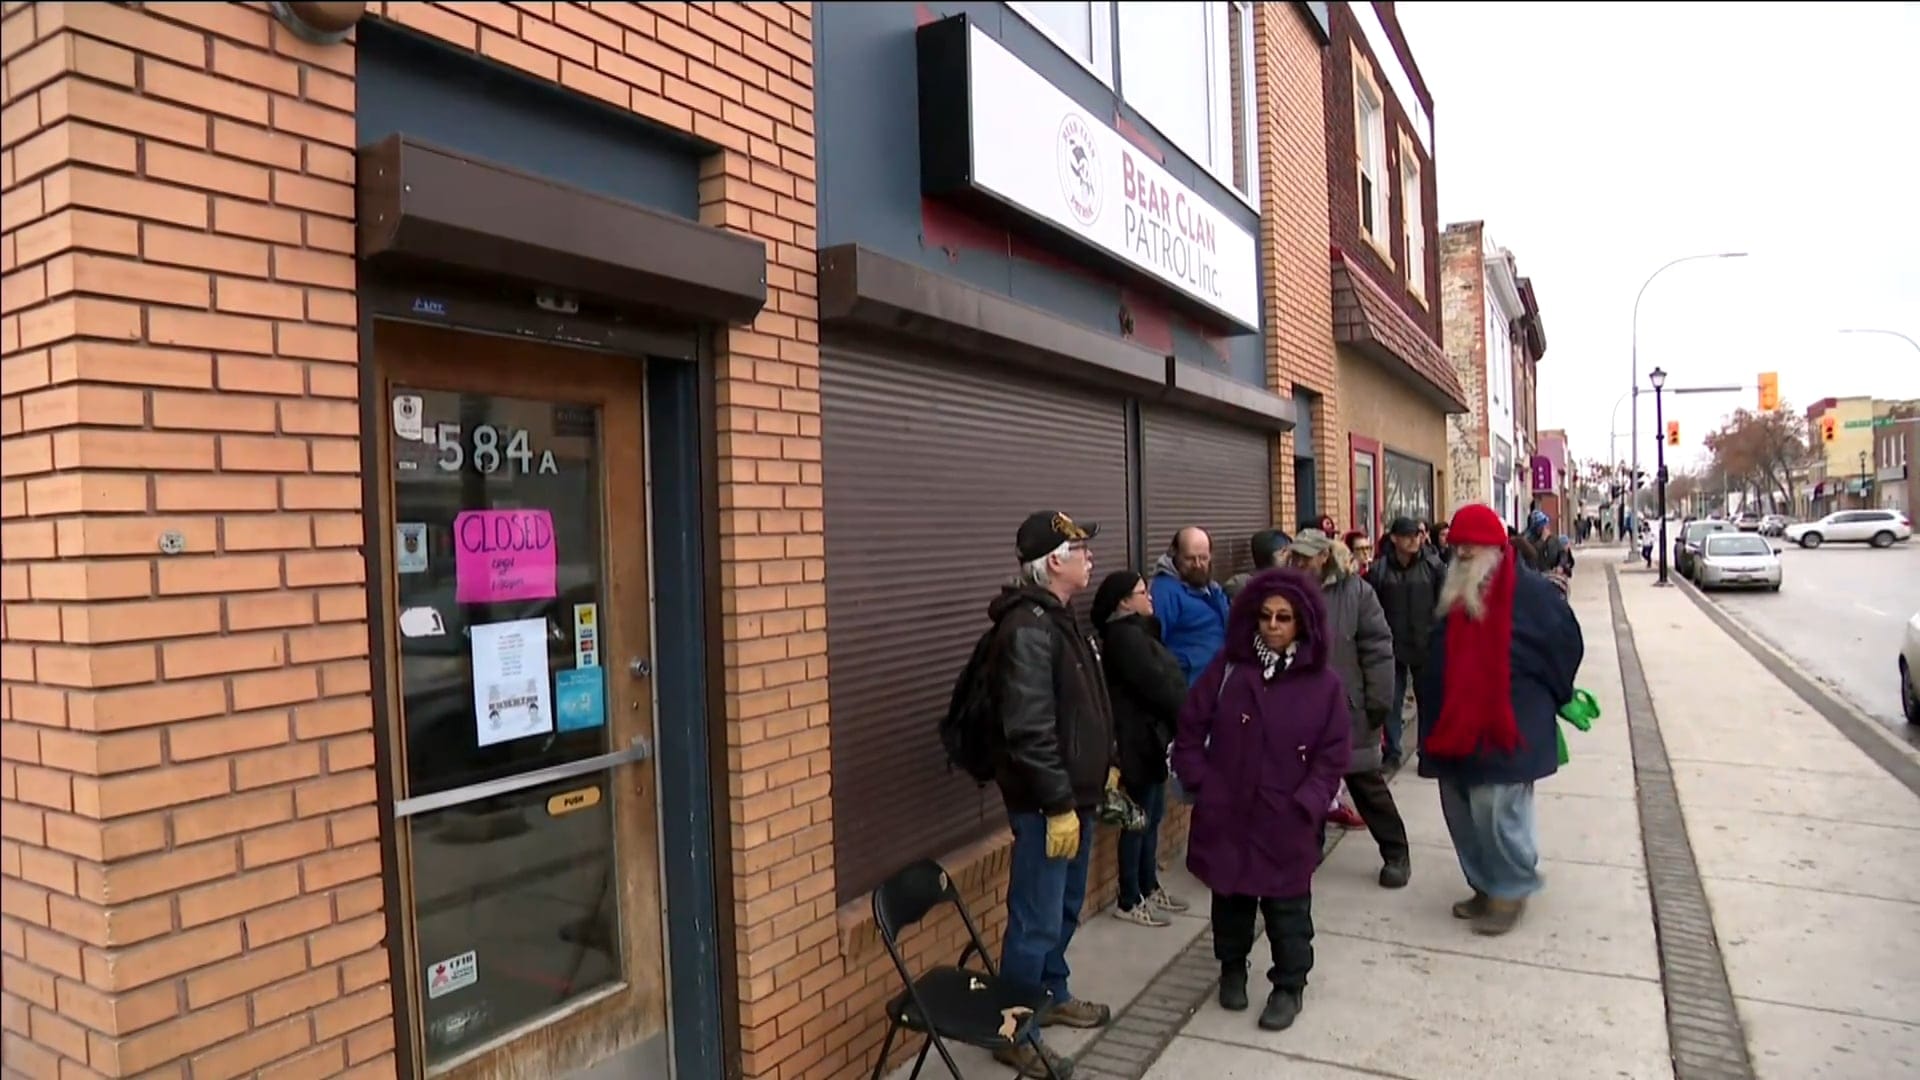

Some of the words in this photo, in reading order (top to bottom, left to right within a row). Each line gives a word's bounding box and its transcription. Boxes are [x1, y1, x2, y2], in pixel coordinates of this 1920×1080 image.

[1122, 149, 1172, 226] BEAR
[1176, 192, 1216, 255] CLAN
[1125, 203, 1196, 285] PATROL
[461, 514, 551, 553] CLOSED
